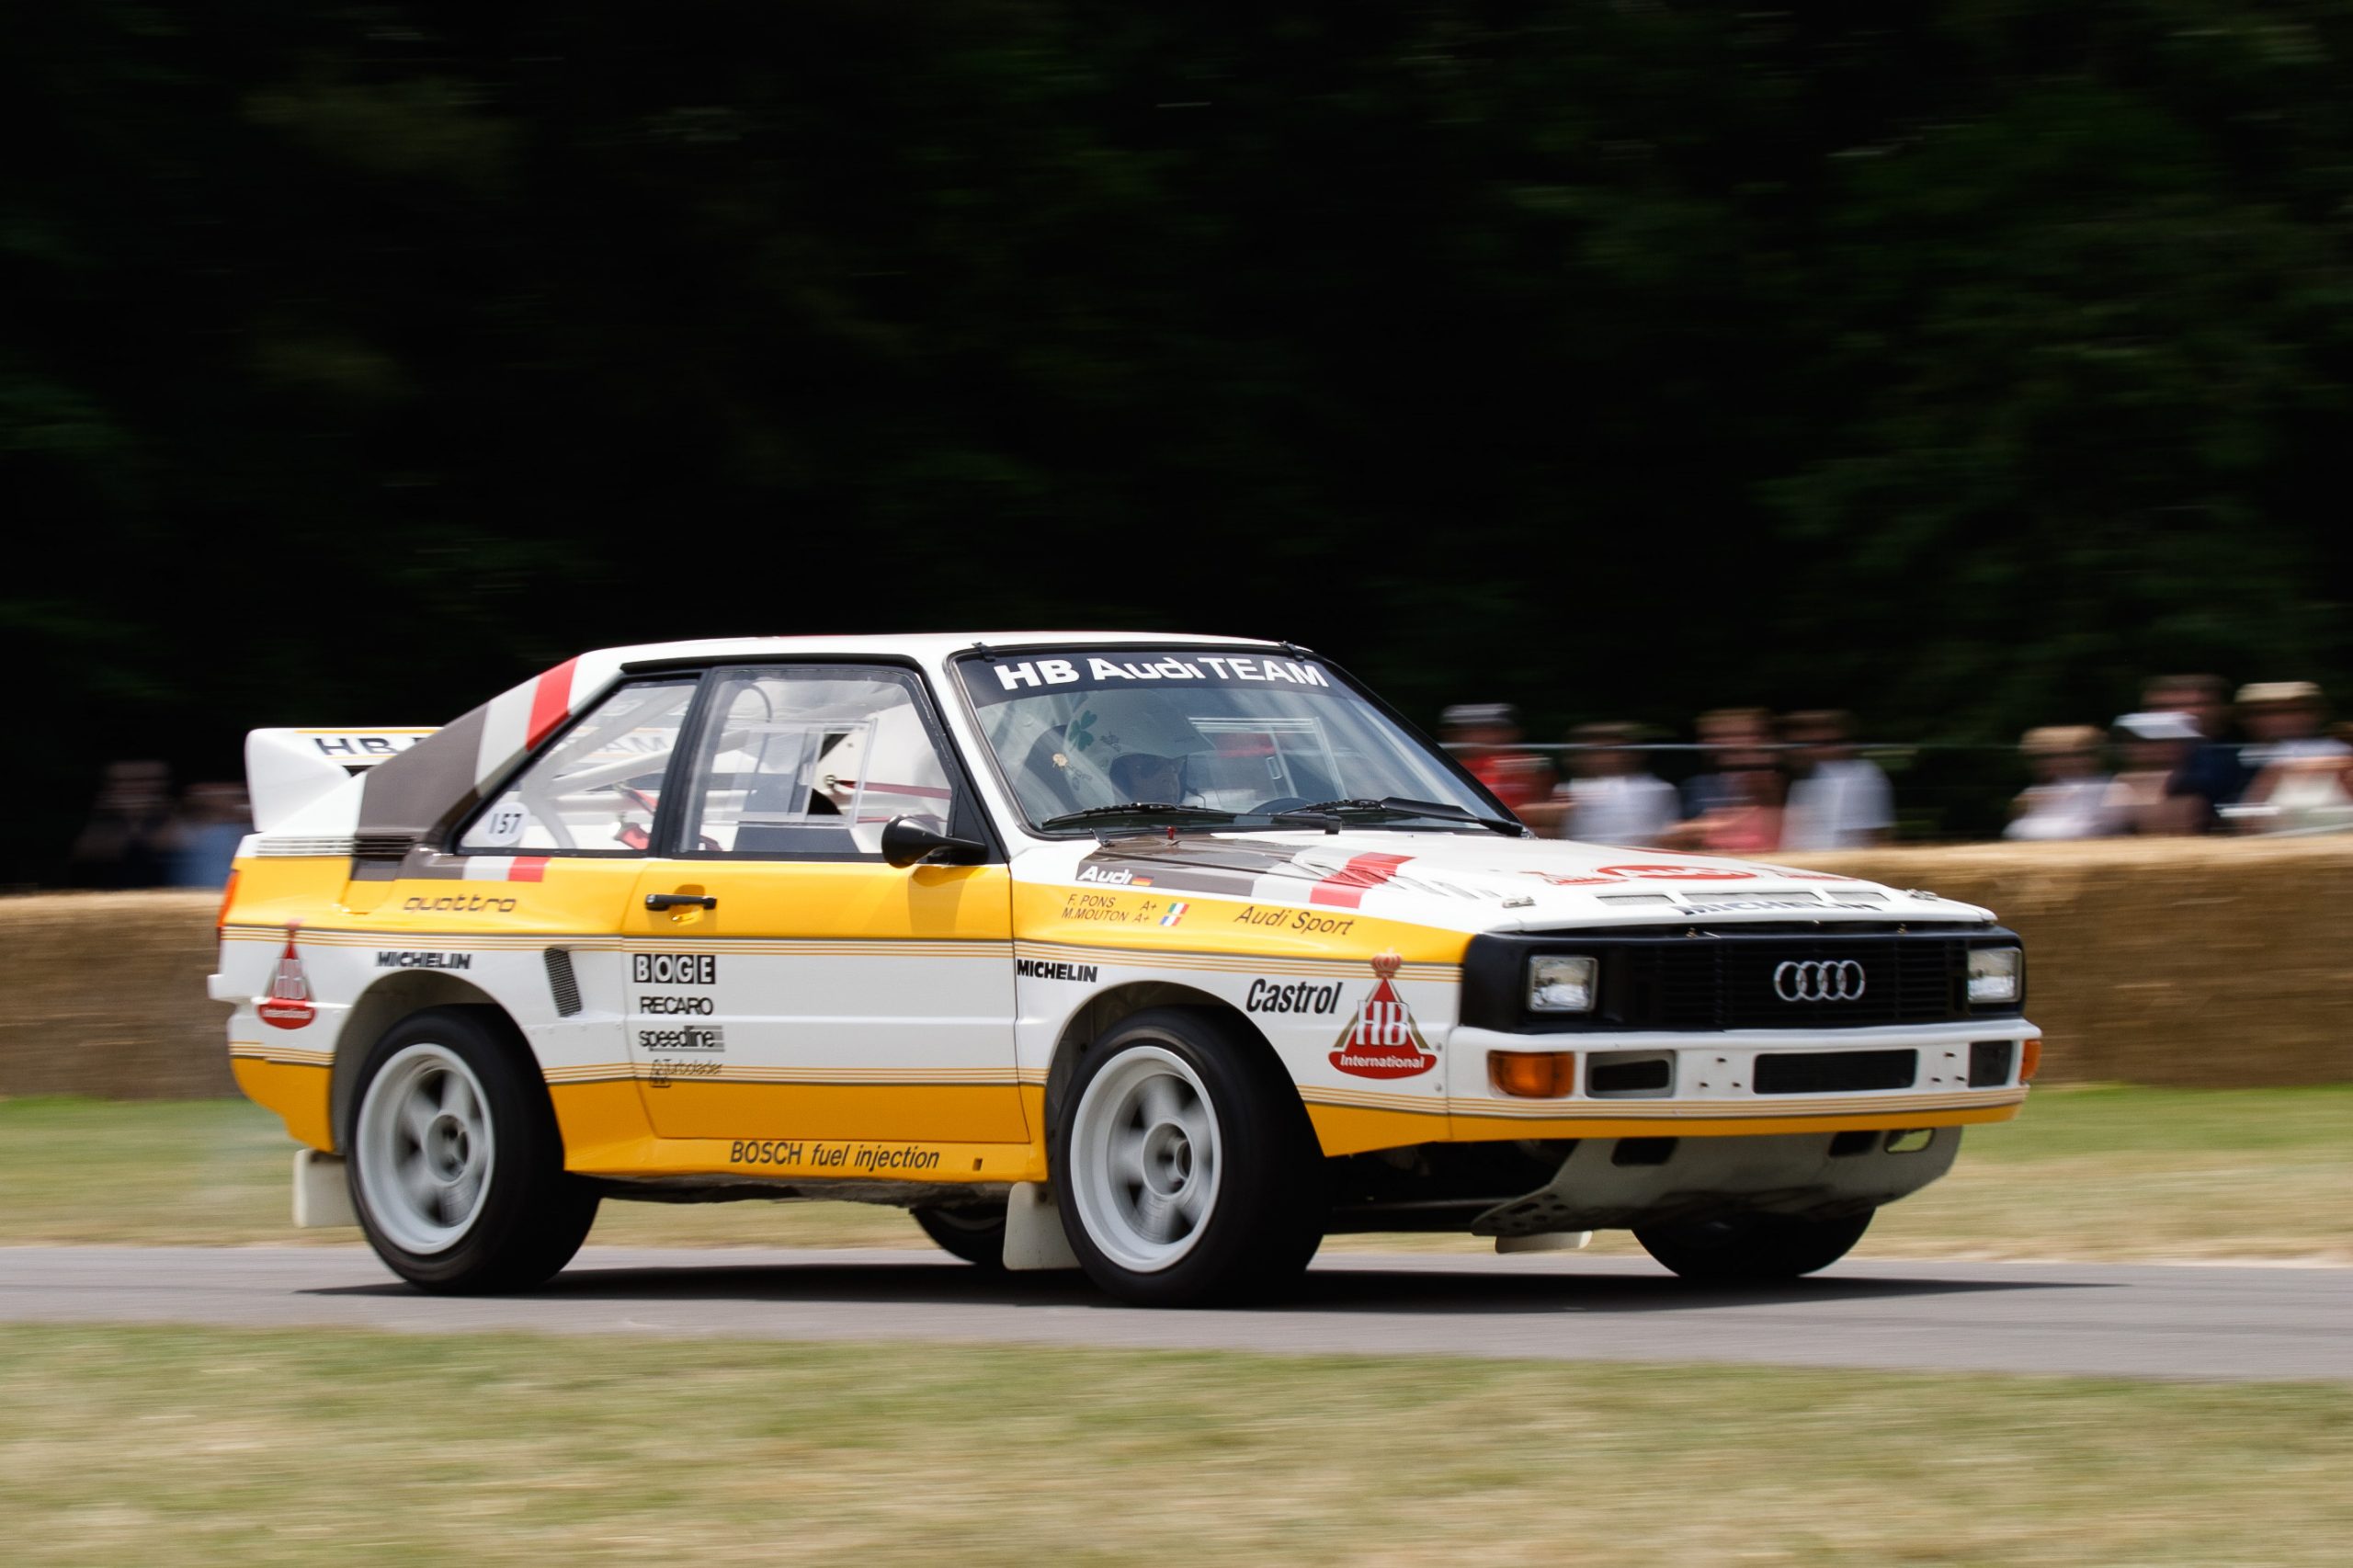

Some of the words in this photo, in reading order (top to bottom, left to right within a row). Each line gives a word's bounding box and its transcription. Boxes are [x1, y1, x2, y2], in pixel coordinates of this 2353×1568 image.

[994, 659, 1079, 689] HB
[1086, 657, 1206, 681] Audi
[1197, 657, 1329, 687] TEAM
[314, 737, 399, 755] HB
[488, 813, 523, 835] 157
[1077, 865, 1133, 885] Audi
[404, 894, 517, 915] quattro
[1080, 894, 1116, 908] PONS
[1140, 900, 1157, 911] A+
[1233, 905, 1292, 926] Audi
[1291, 911, 1355, 936] Sport
[378, 951, 472, 970] MICHELIN
[634, 954, 715, 983] BOGE
[1017, 959, 1098, 983] MICHELIN
[640, 995, 714, 1016] RECARO
[1245, 978, 1344, 1014] Castrol
[1356, 999, 1411, 1046] HB
[1340, 1053, 1426, 1069] International
[730, 1141, 802, 1165] BOSCH
[810, 1143, 850, 1166] fuel
[854, 1145, 939, 1172] injection
